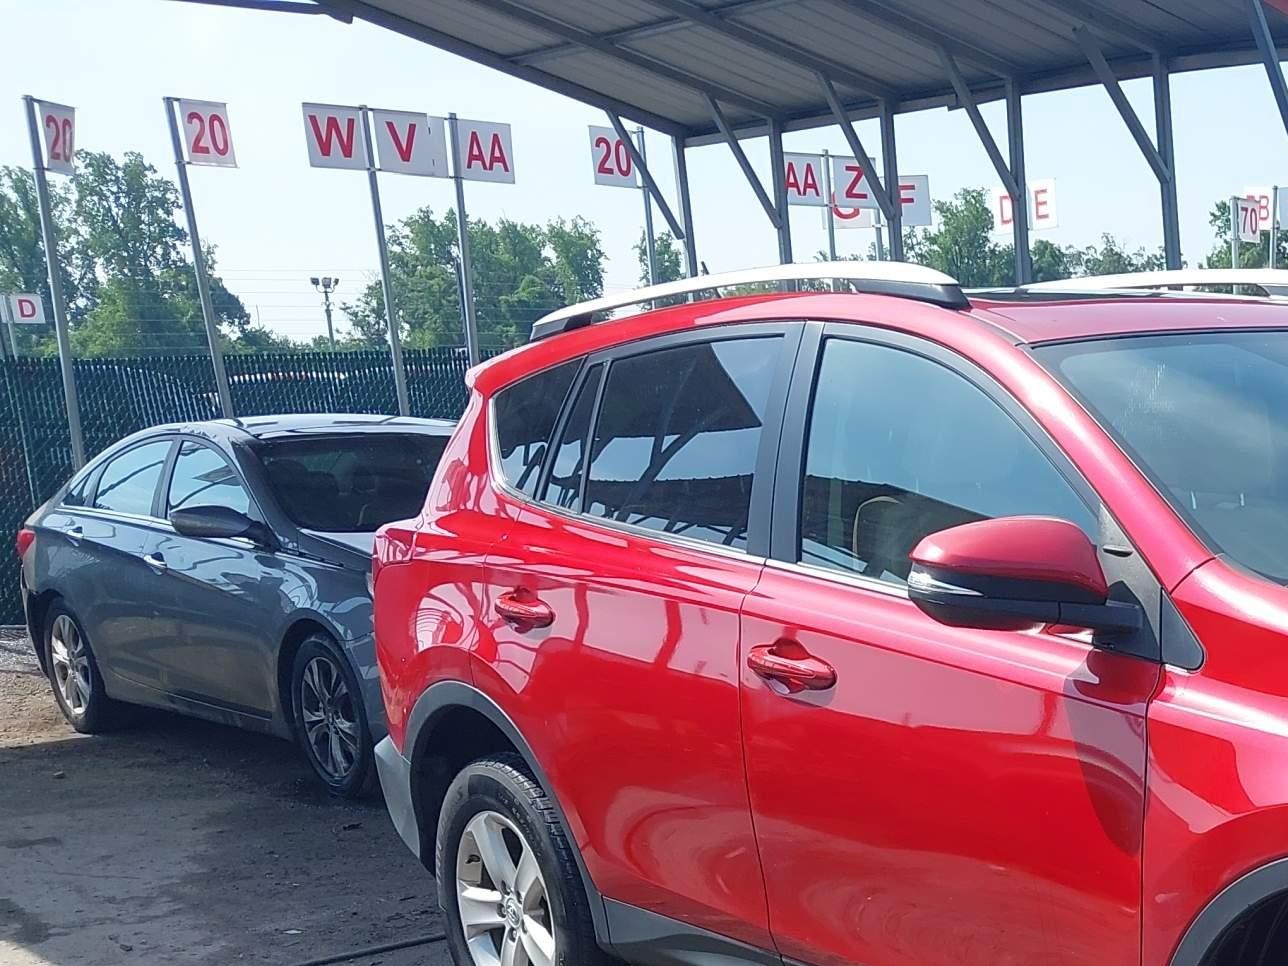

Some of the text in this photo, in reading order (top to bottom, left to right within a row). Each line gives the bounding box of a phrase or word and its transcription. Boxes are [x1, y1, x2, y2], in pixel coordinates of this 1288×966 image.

[45, 114, 73, 163] 20
[187, 111, 229, 156] 20
[308, 114, 355, 159] W
[385, 120, 416, 163] V
[466, 130, 510, 173] AA
[594, 136, 631, 178] 20
[785, 161, 820, 197] AA
[845, 165, 868, 200] Z
[1034, 188, 1050, 220] E
[1240, 206, 1258, 235] 70
[17, 298, 36, 318] D
